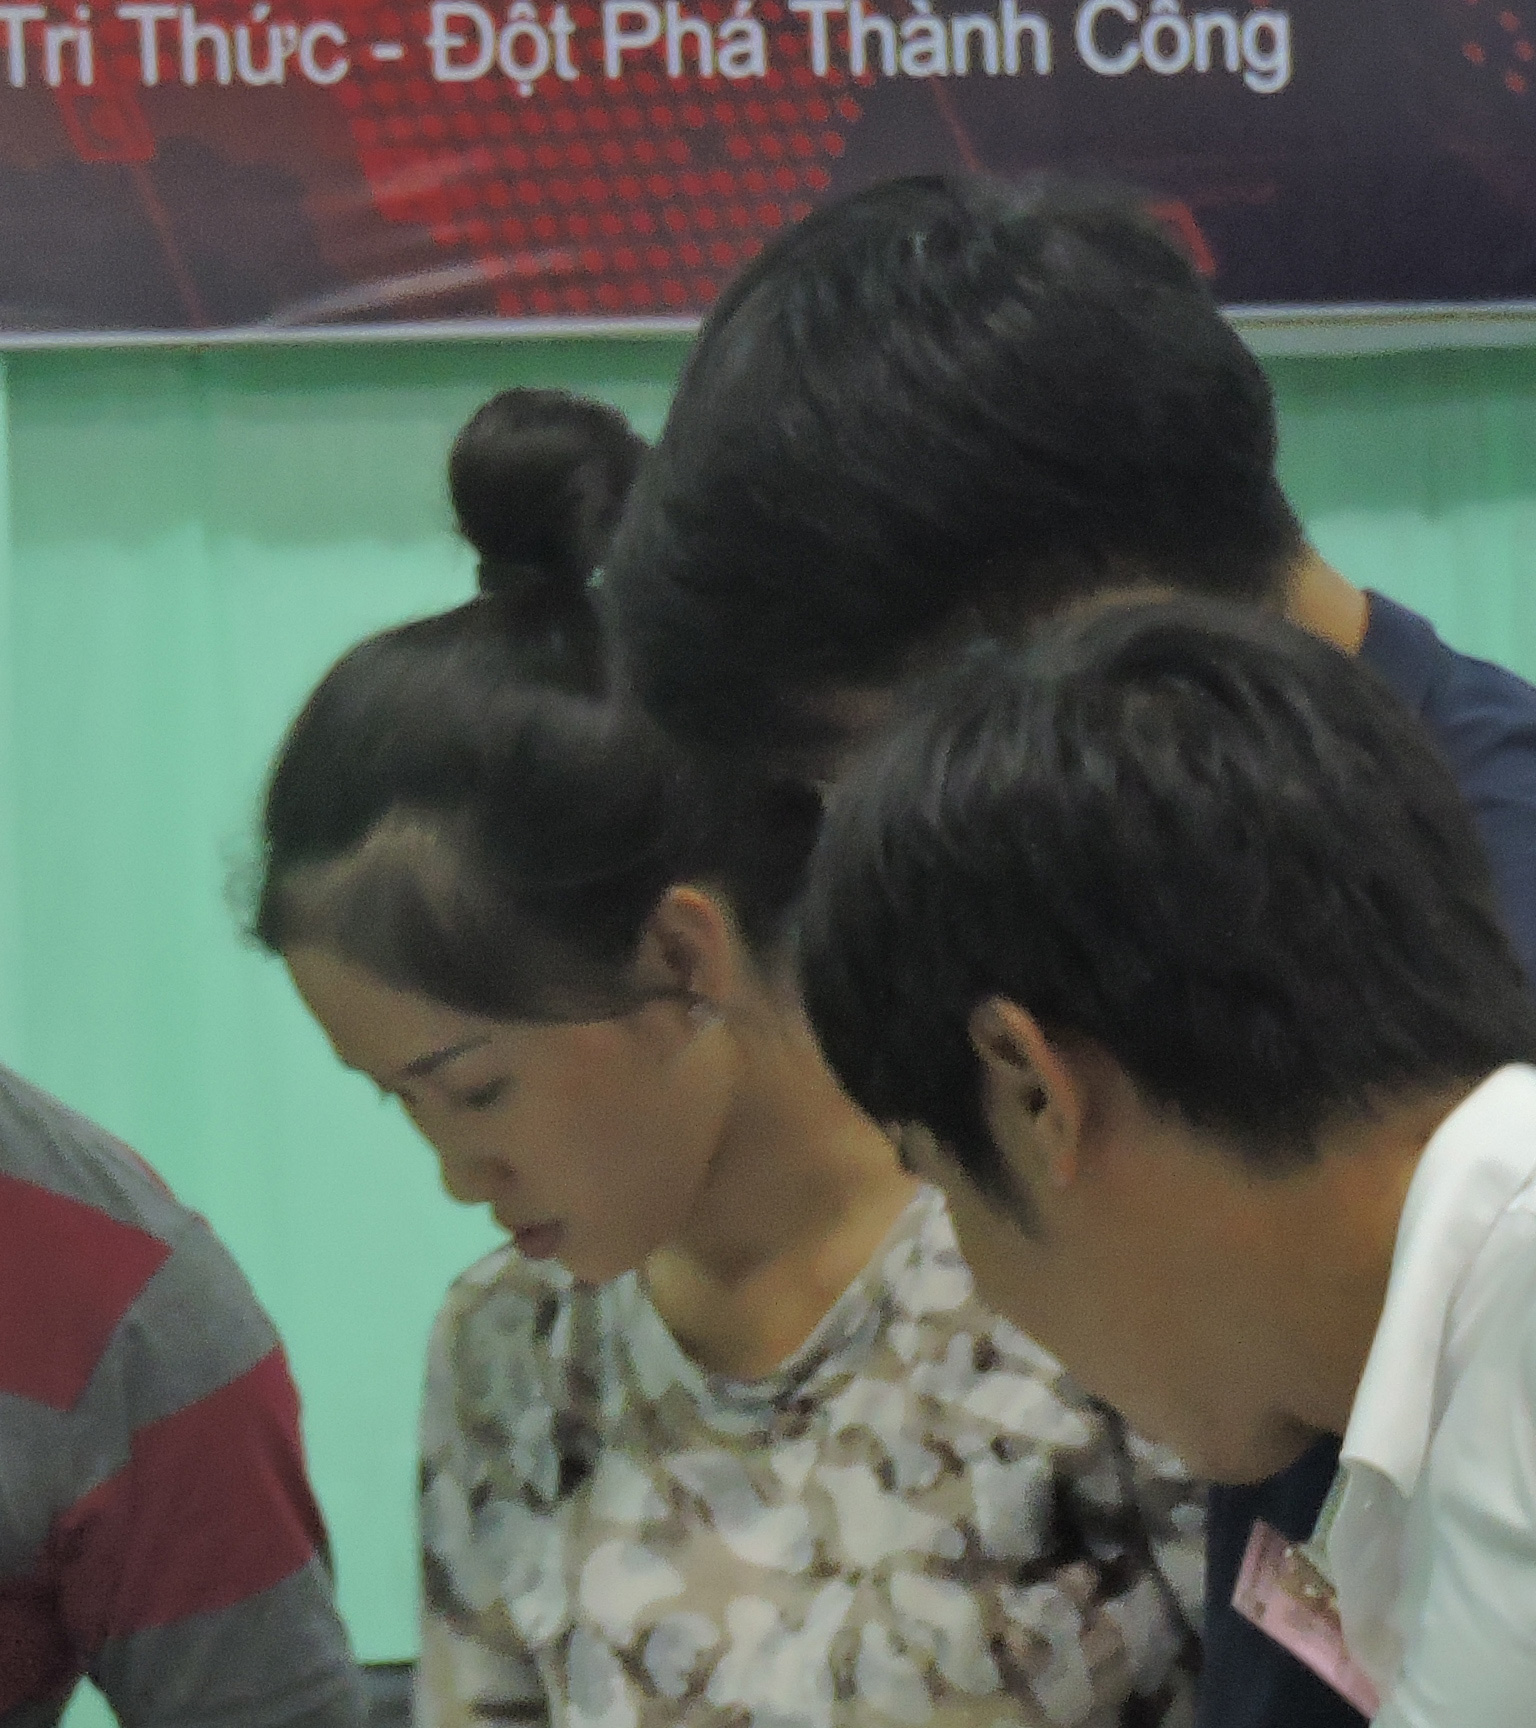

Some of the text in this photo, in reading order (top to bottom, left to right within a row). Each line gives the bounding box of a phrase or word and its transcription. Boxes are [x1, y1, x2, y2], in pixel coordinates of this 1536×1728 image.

[116, 3, 349, 87] Thức
[425, 0, 579, 97] Đột
[602, 0, 767, 80] Phá
[786, 0, 1051, 77] Thành
[1075, 0, 1292, 93] Công
